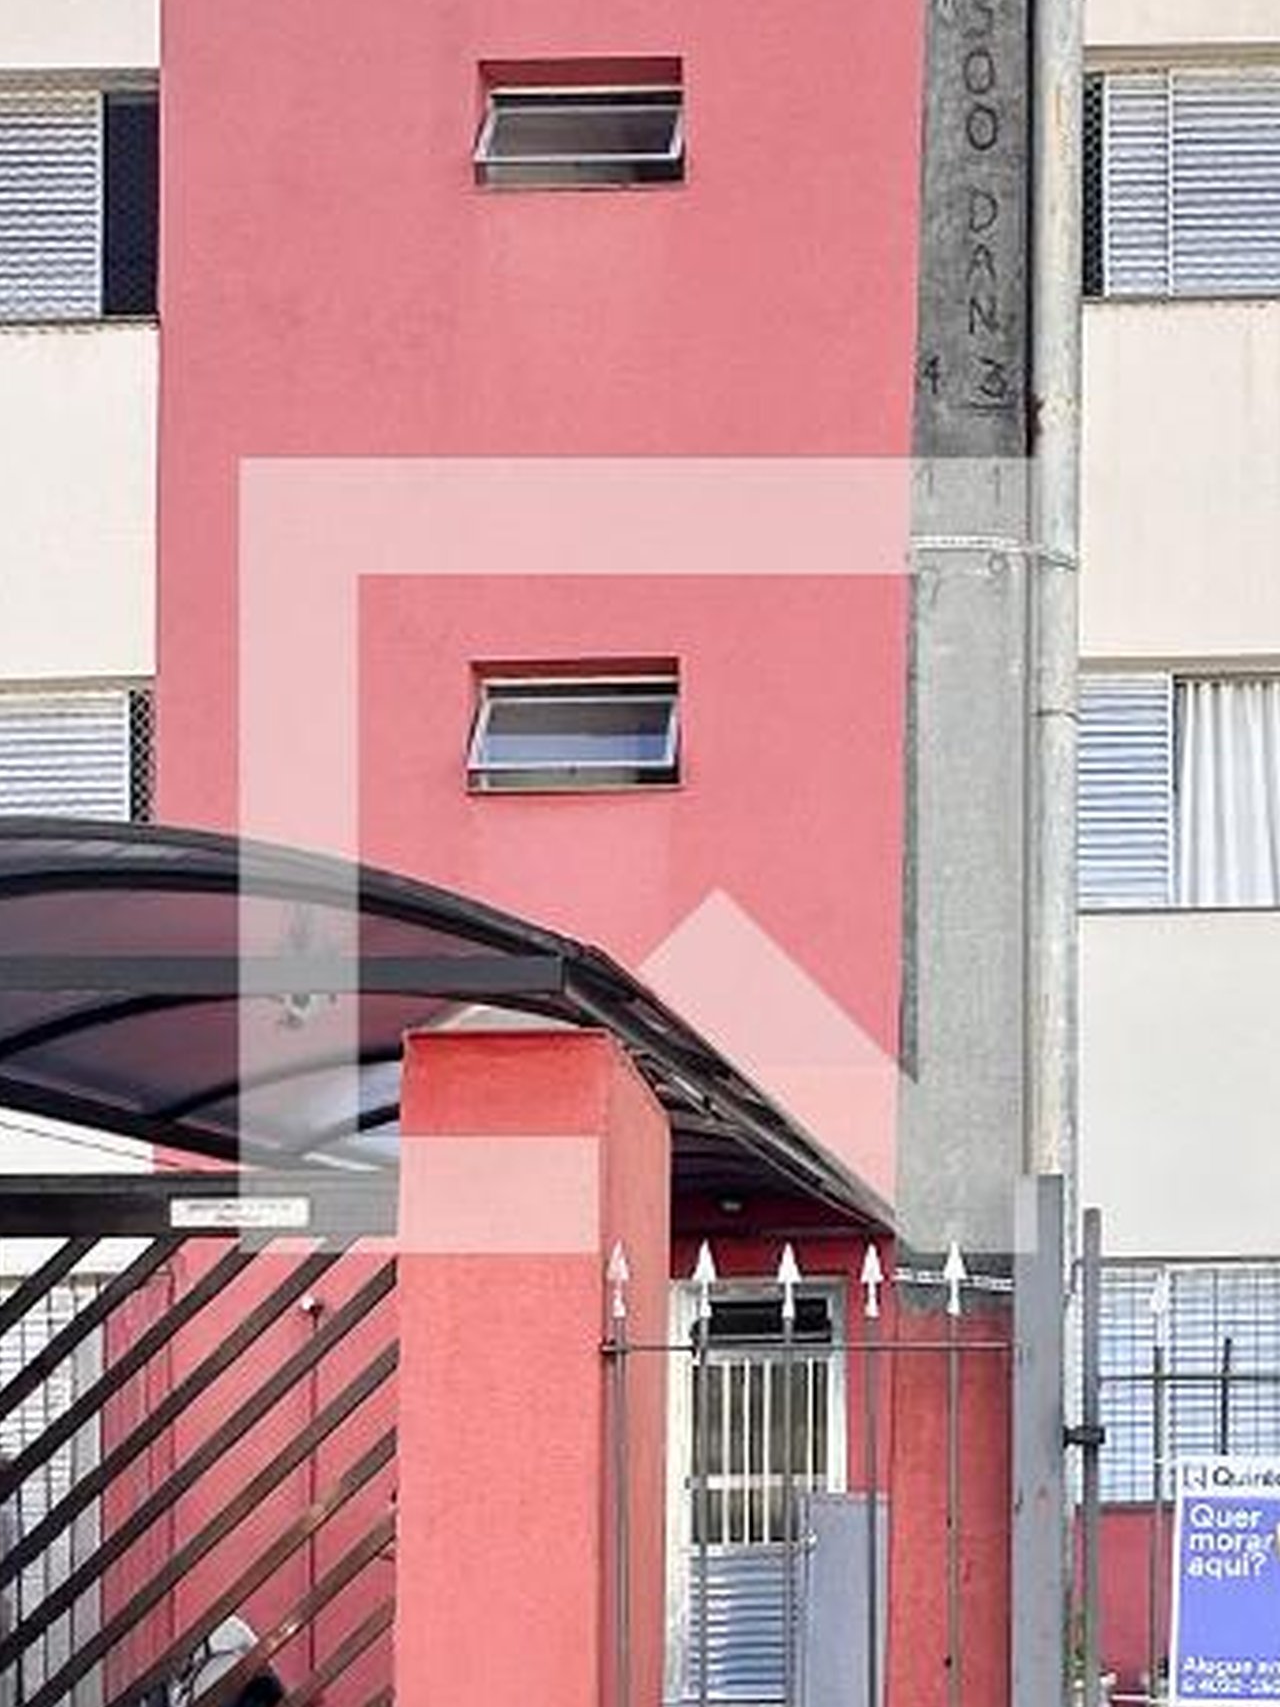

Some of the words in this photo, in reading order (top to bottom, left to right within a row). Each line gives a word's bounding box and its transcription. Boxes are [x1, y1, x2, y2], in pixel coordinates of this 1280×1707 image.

[1190, 1503, 1263, 1529] Quer
[1189, 1533, 1275, 1553] morar
[1187, 1552, 1267, 1581] aqui?
